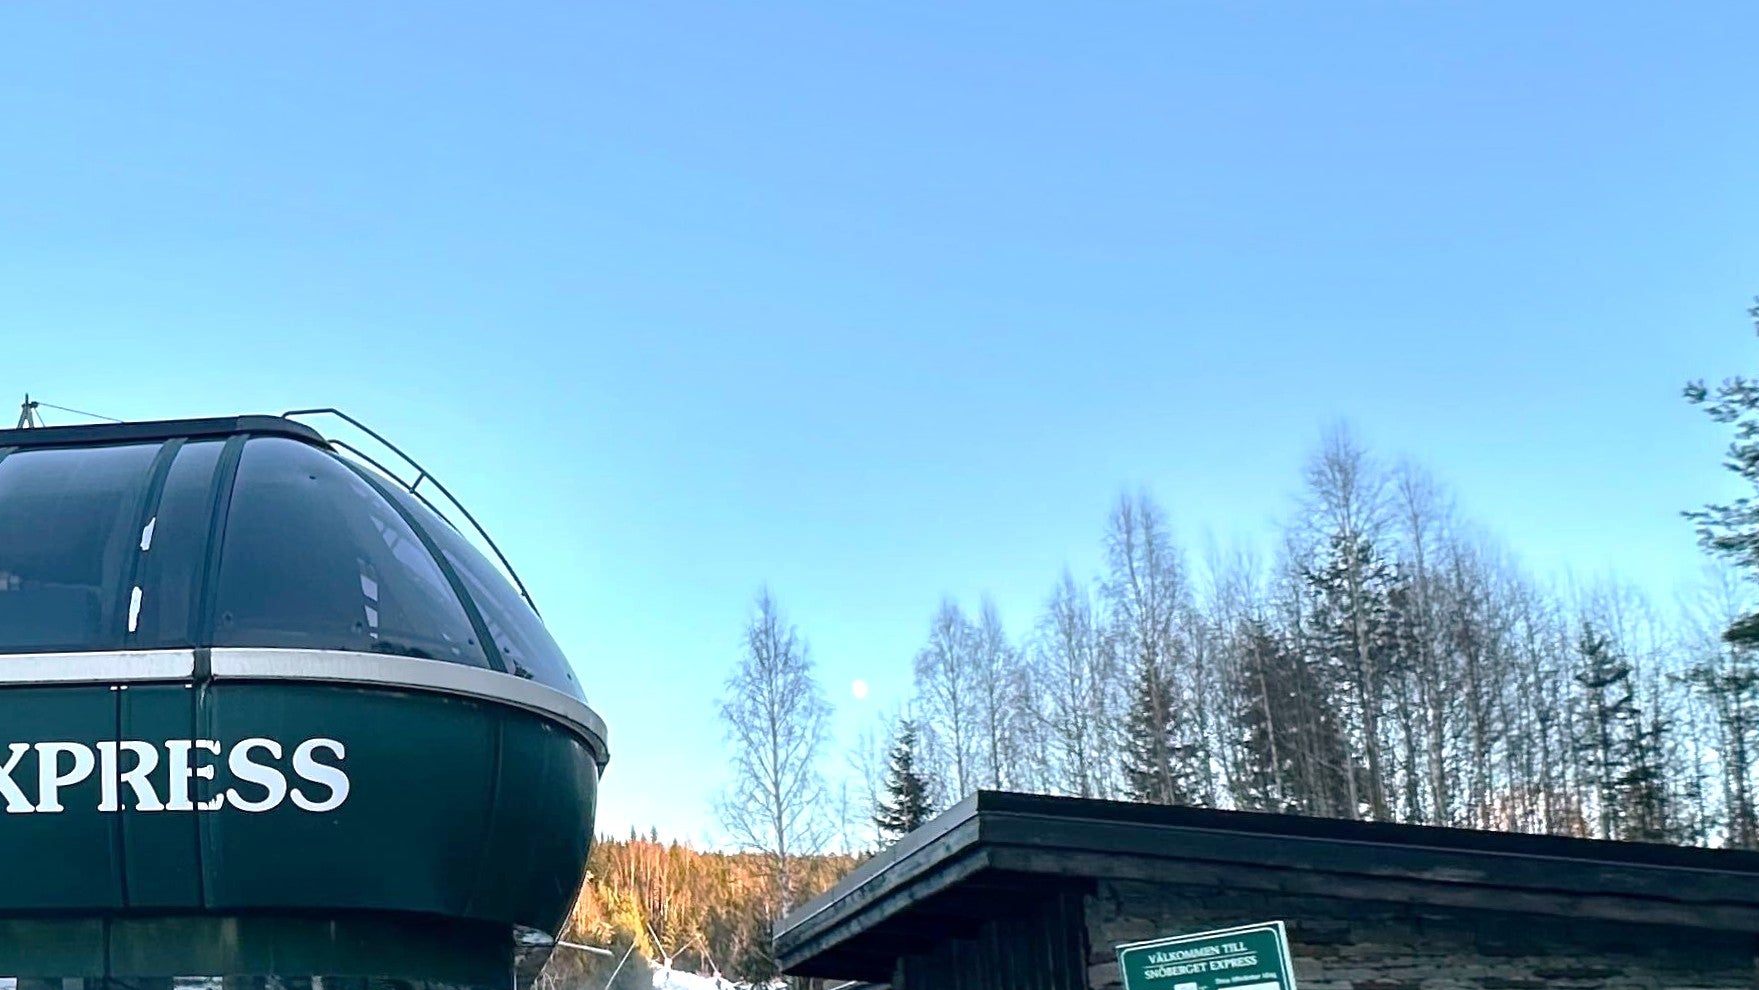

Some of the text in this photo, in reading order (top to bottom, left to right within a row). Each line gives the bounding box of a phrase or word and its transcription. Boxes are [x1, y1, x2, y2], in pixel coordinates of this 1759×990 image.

[1148, 941, 1249, 964] VÄLKOMMEN TILL
[1144, 962, 1208, 980] SNÖBERGET
[1209, 956, 1258, 971] EXPRESS
